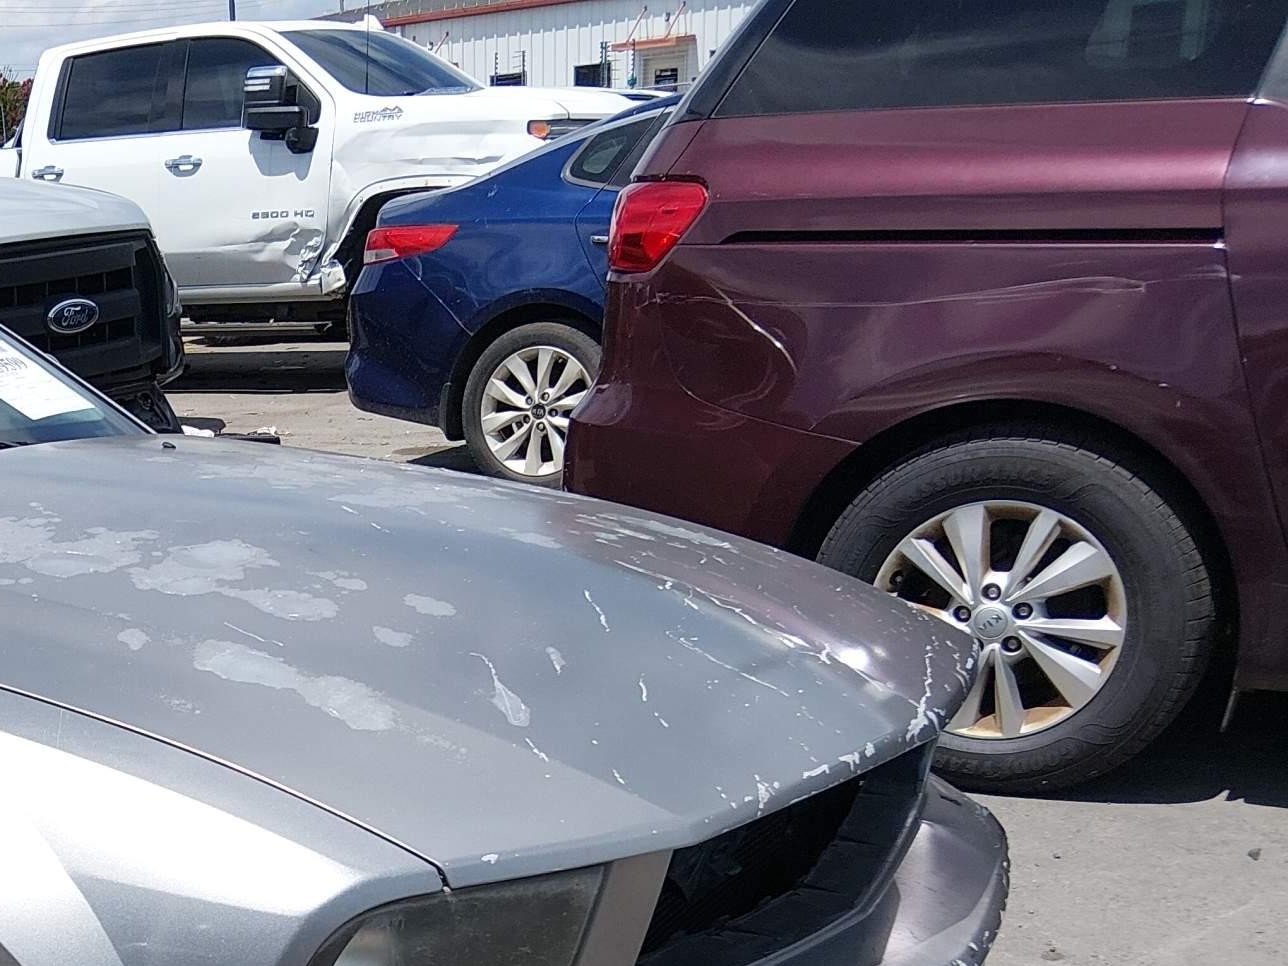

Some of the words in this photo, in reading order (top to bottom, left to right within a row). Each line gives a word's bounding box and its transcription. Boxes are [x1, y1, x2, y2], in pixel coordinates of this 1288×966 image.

[294, 209, 315, 218] HD
[61, 306, 89, 326] Ford
[978, 614, 1002, 630] KIA
